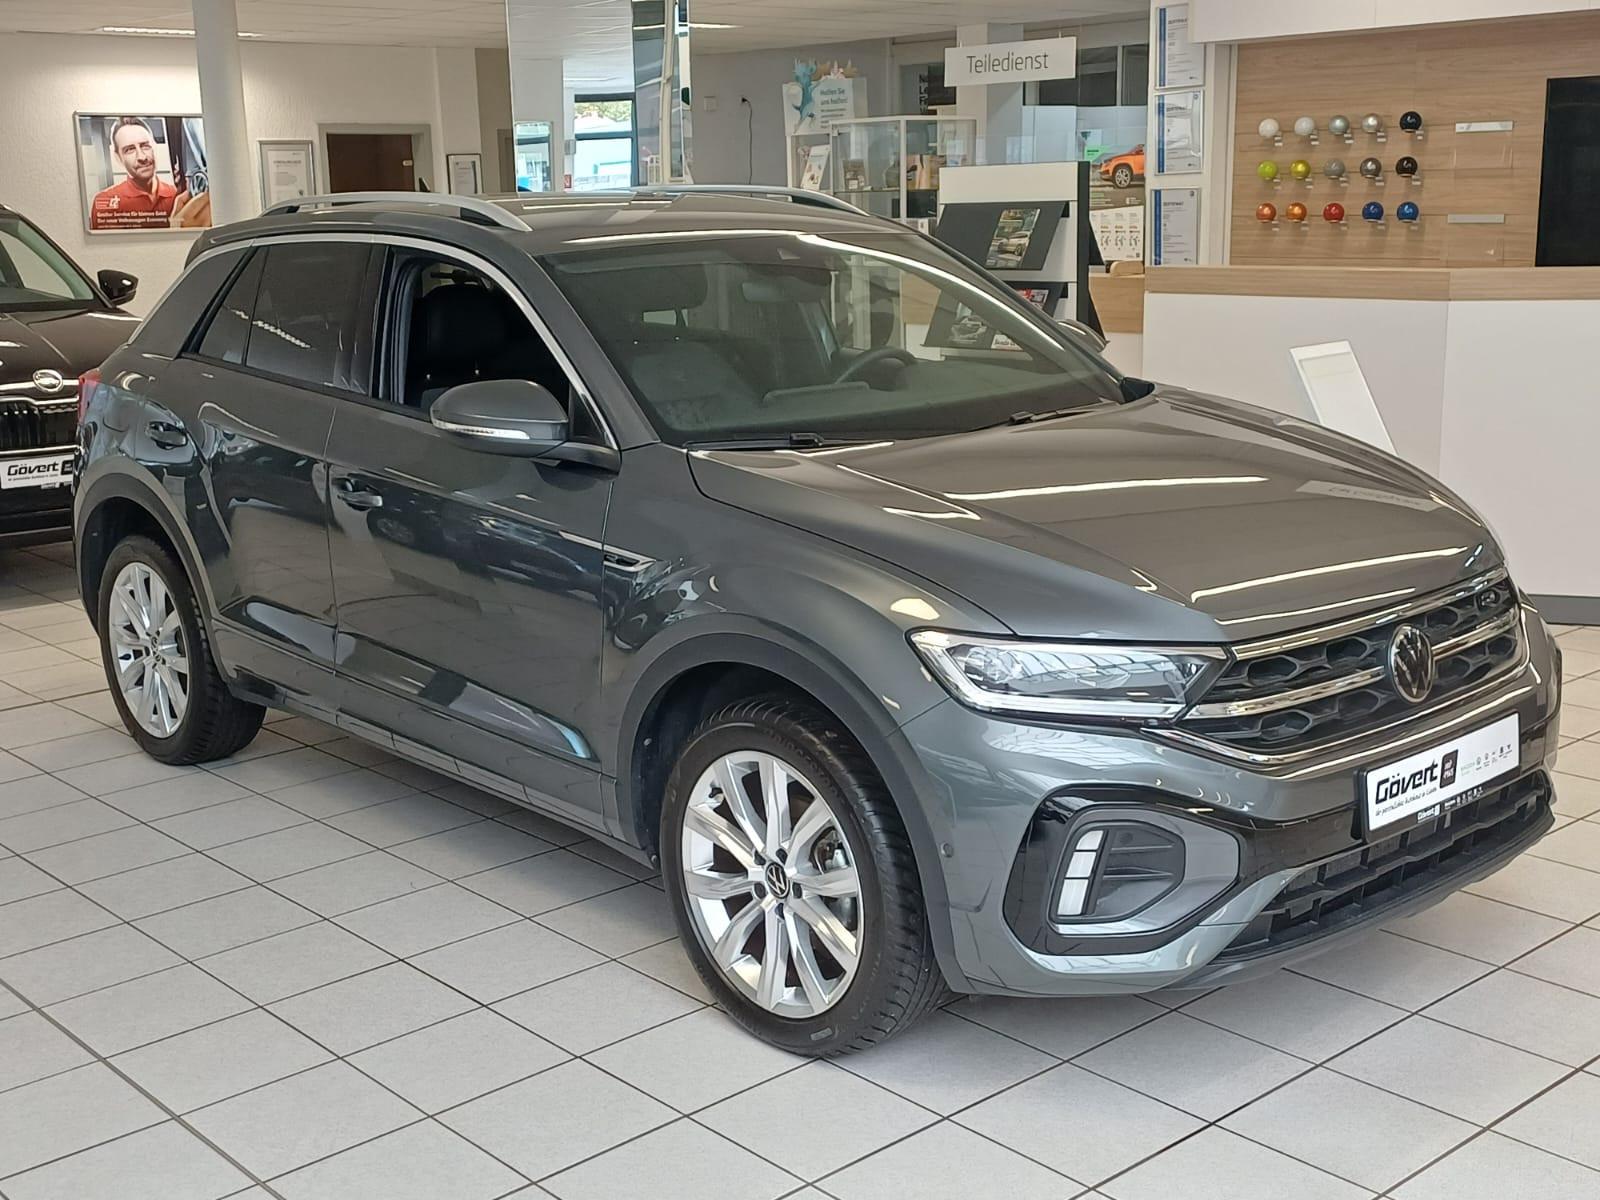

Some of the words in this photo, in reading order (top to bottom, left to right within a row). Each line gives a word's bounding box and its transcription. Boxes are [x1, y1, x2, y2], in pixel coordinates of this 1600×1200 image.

[966, 52, 1049, 73] Teiledienst
[8, 461, 59, 476] Gövert
[1375, 759, 1439, 805] Gövert
